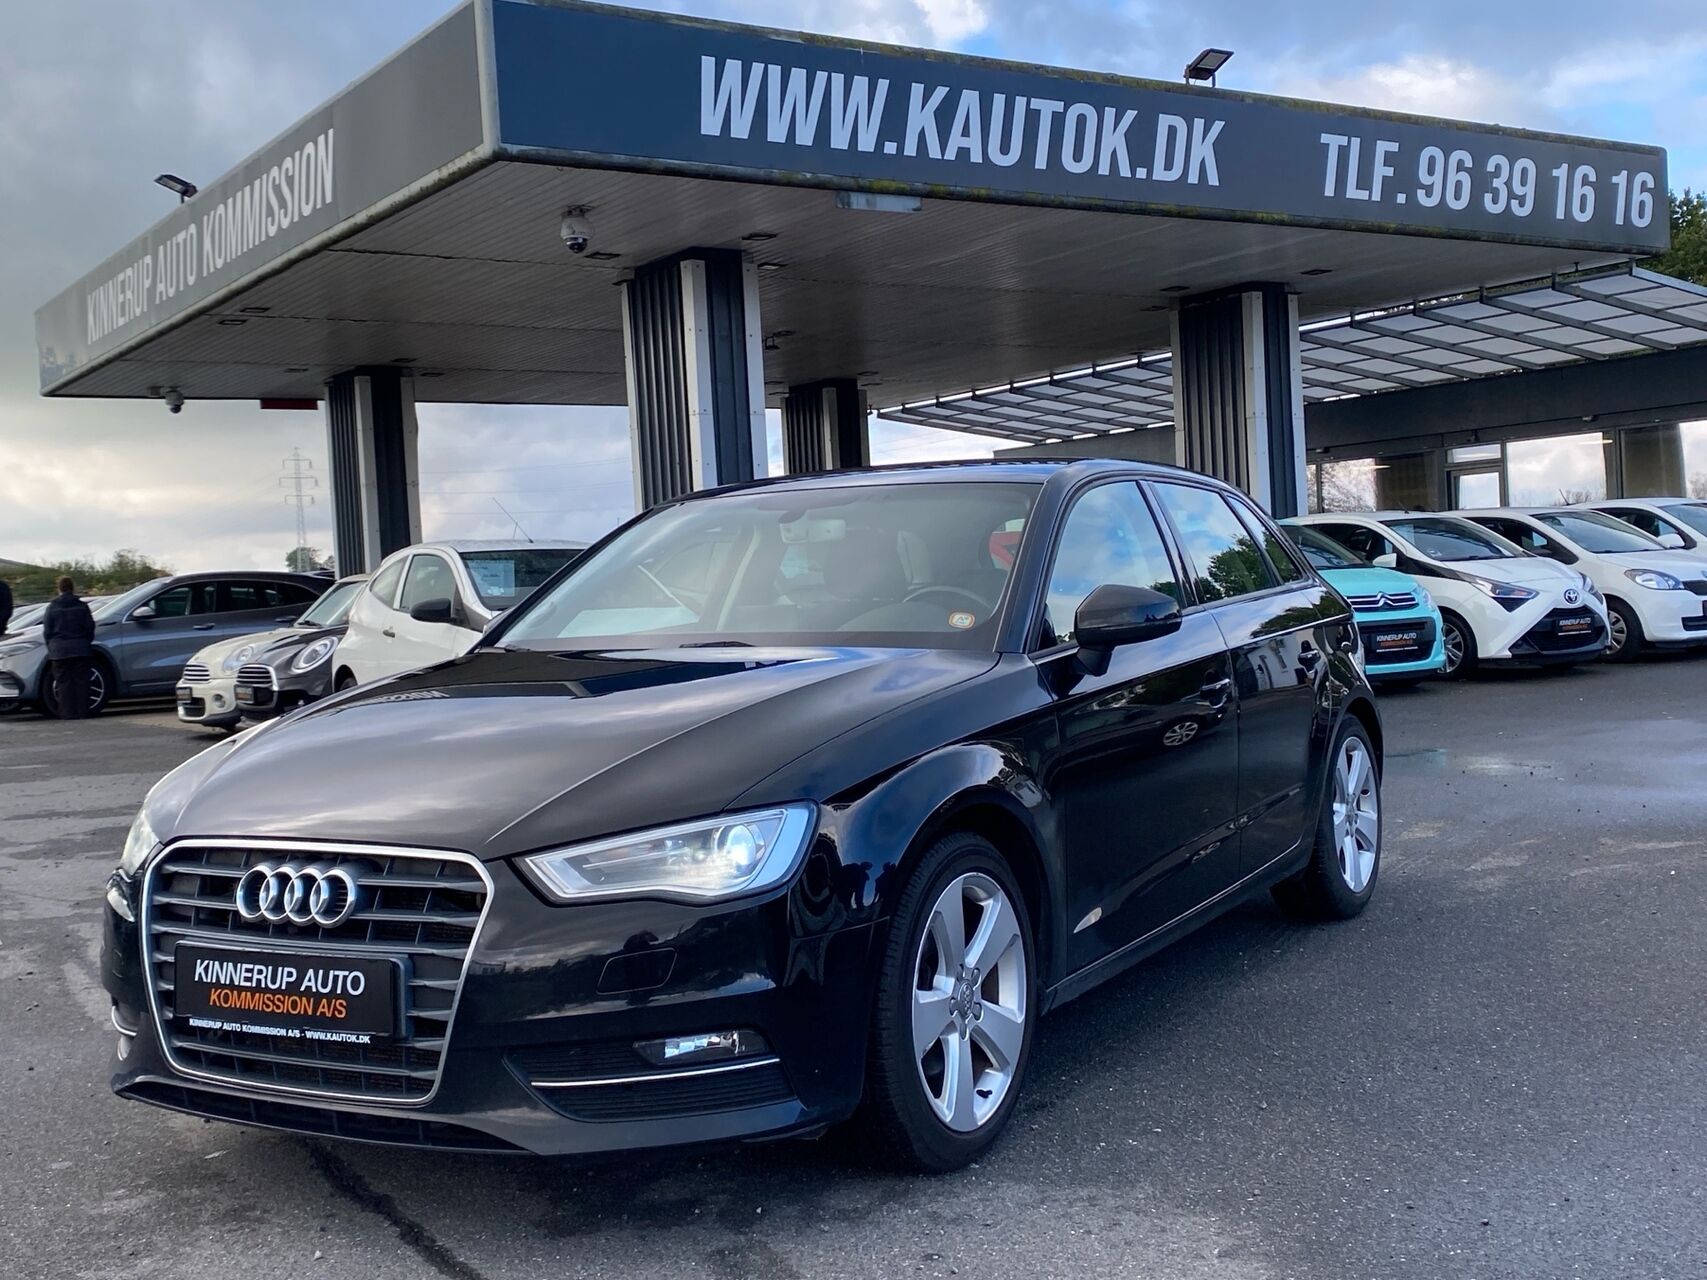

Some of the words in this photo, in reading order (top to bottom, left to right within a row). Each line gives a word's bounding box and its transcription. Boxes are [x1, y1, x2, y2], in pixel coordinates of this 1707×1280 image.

[701, 55, 1225, 187] WWW.KAUTOK.DK
[1320, 133, 1407, 204] TLF.
[1416, 146, 1473, 210] 96
[1483, 154, 1537, 217] 39
[1552, 163, 1597, 223] 16
[1611, 170, 1655, 228] 16
[87, 255, 152, 344] KINNERUP
[155, 223, 197, 304] AUTO
[203, 128, 334, 277] KOMMISSION
[194, 959, 297, 991] KINNERUP
[300, 968, 365, 996] AUTO
[209, 988, 314, 1015] KOMMISSION
[317, 997, 347, 1018] A/S
[189, 1018, 222, 1029] KINNERUP
[222, 1022, 241, 1031] AUTO
[242, 1024, 286, 1036] KOMMISSION
[287, 1029, 300, 1037] A/S
[305, 1031, 371, 1043] WWW.KAUTOK.DK
